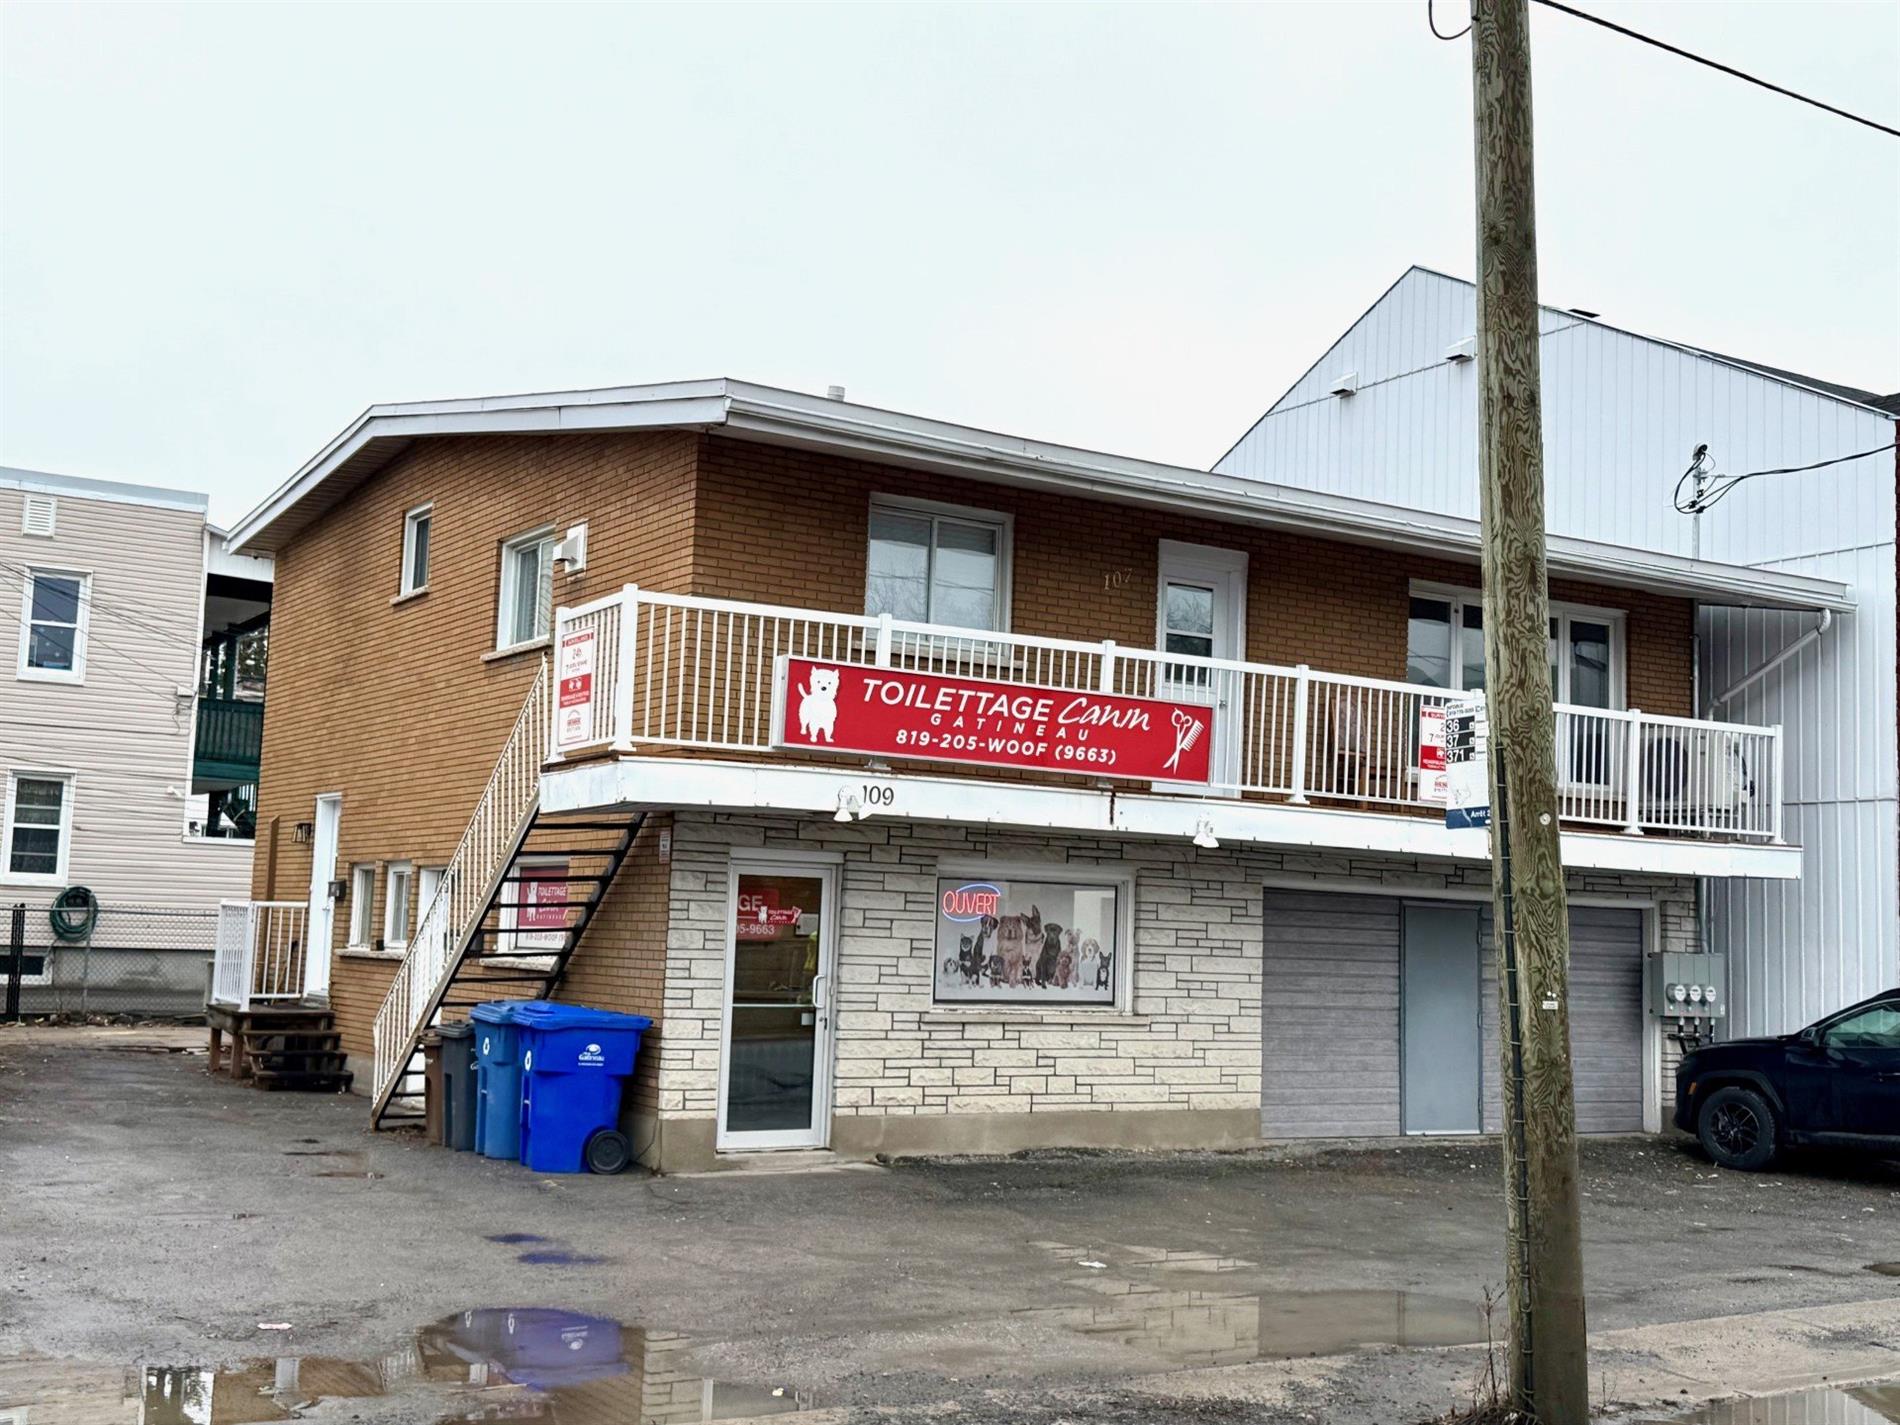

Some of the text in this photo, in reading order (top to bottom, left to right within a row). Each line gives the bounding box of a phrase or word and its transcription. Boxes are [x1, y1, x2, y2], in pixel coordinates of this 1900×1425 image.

[1104, 567, 1133, 590] 107
[863, 678, 1054, 721] TOILETTAGE
[930, 713, 1089, 741] GATINEAU
[1446, 719, 1460, 733] 36
[896, 729, 1117, 765] 819-205-WOOF (9663)
[1446, 734, 1459, 748] 37
[1446, 749, 1465, 763] 371
[862, 785, 894, 806] 109
[943, 891, 1000, 914] OUVERT
